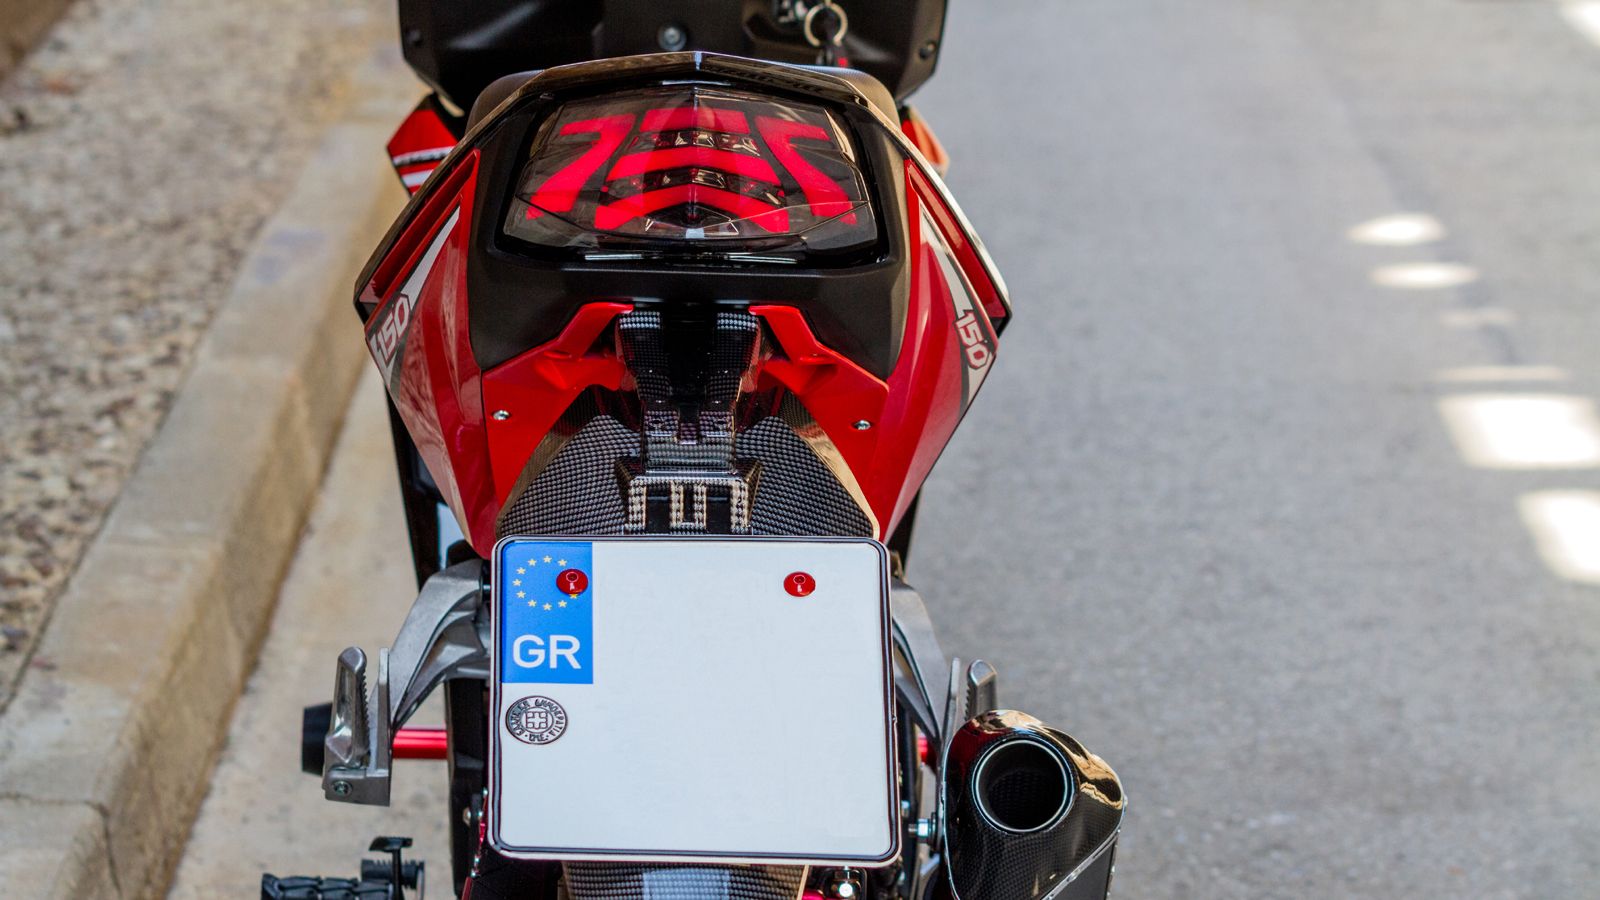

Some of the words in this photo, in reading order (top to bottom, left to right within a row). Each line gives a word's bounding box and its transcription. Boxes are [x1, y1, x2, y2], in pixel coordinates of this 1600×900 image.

[376, 295, 410, 361] 150
[955, 311, 990, 369] 150
[512, 634, 582, 669] GR
